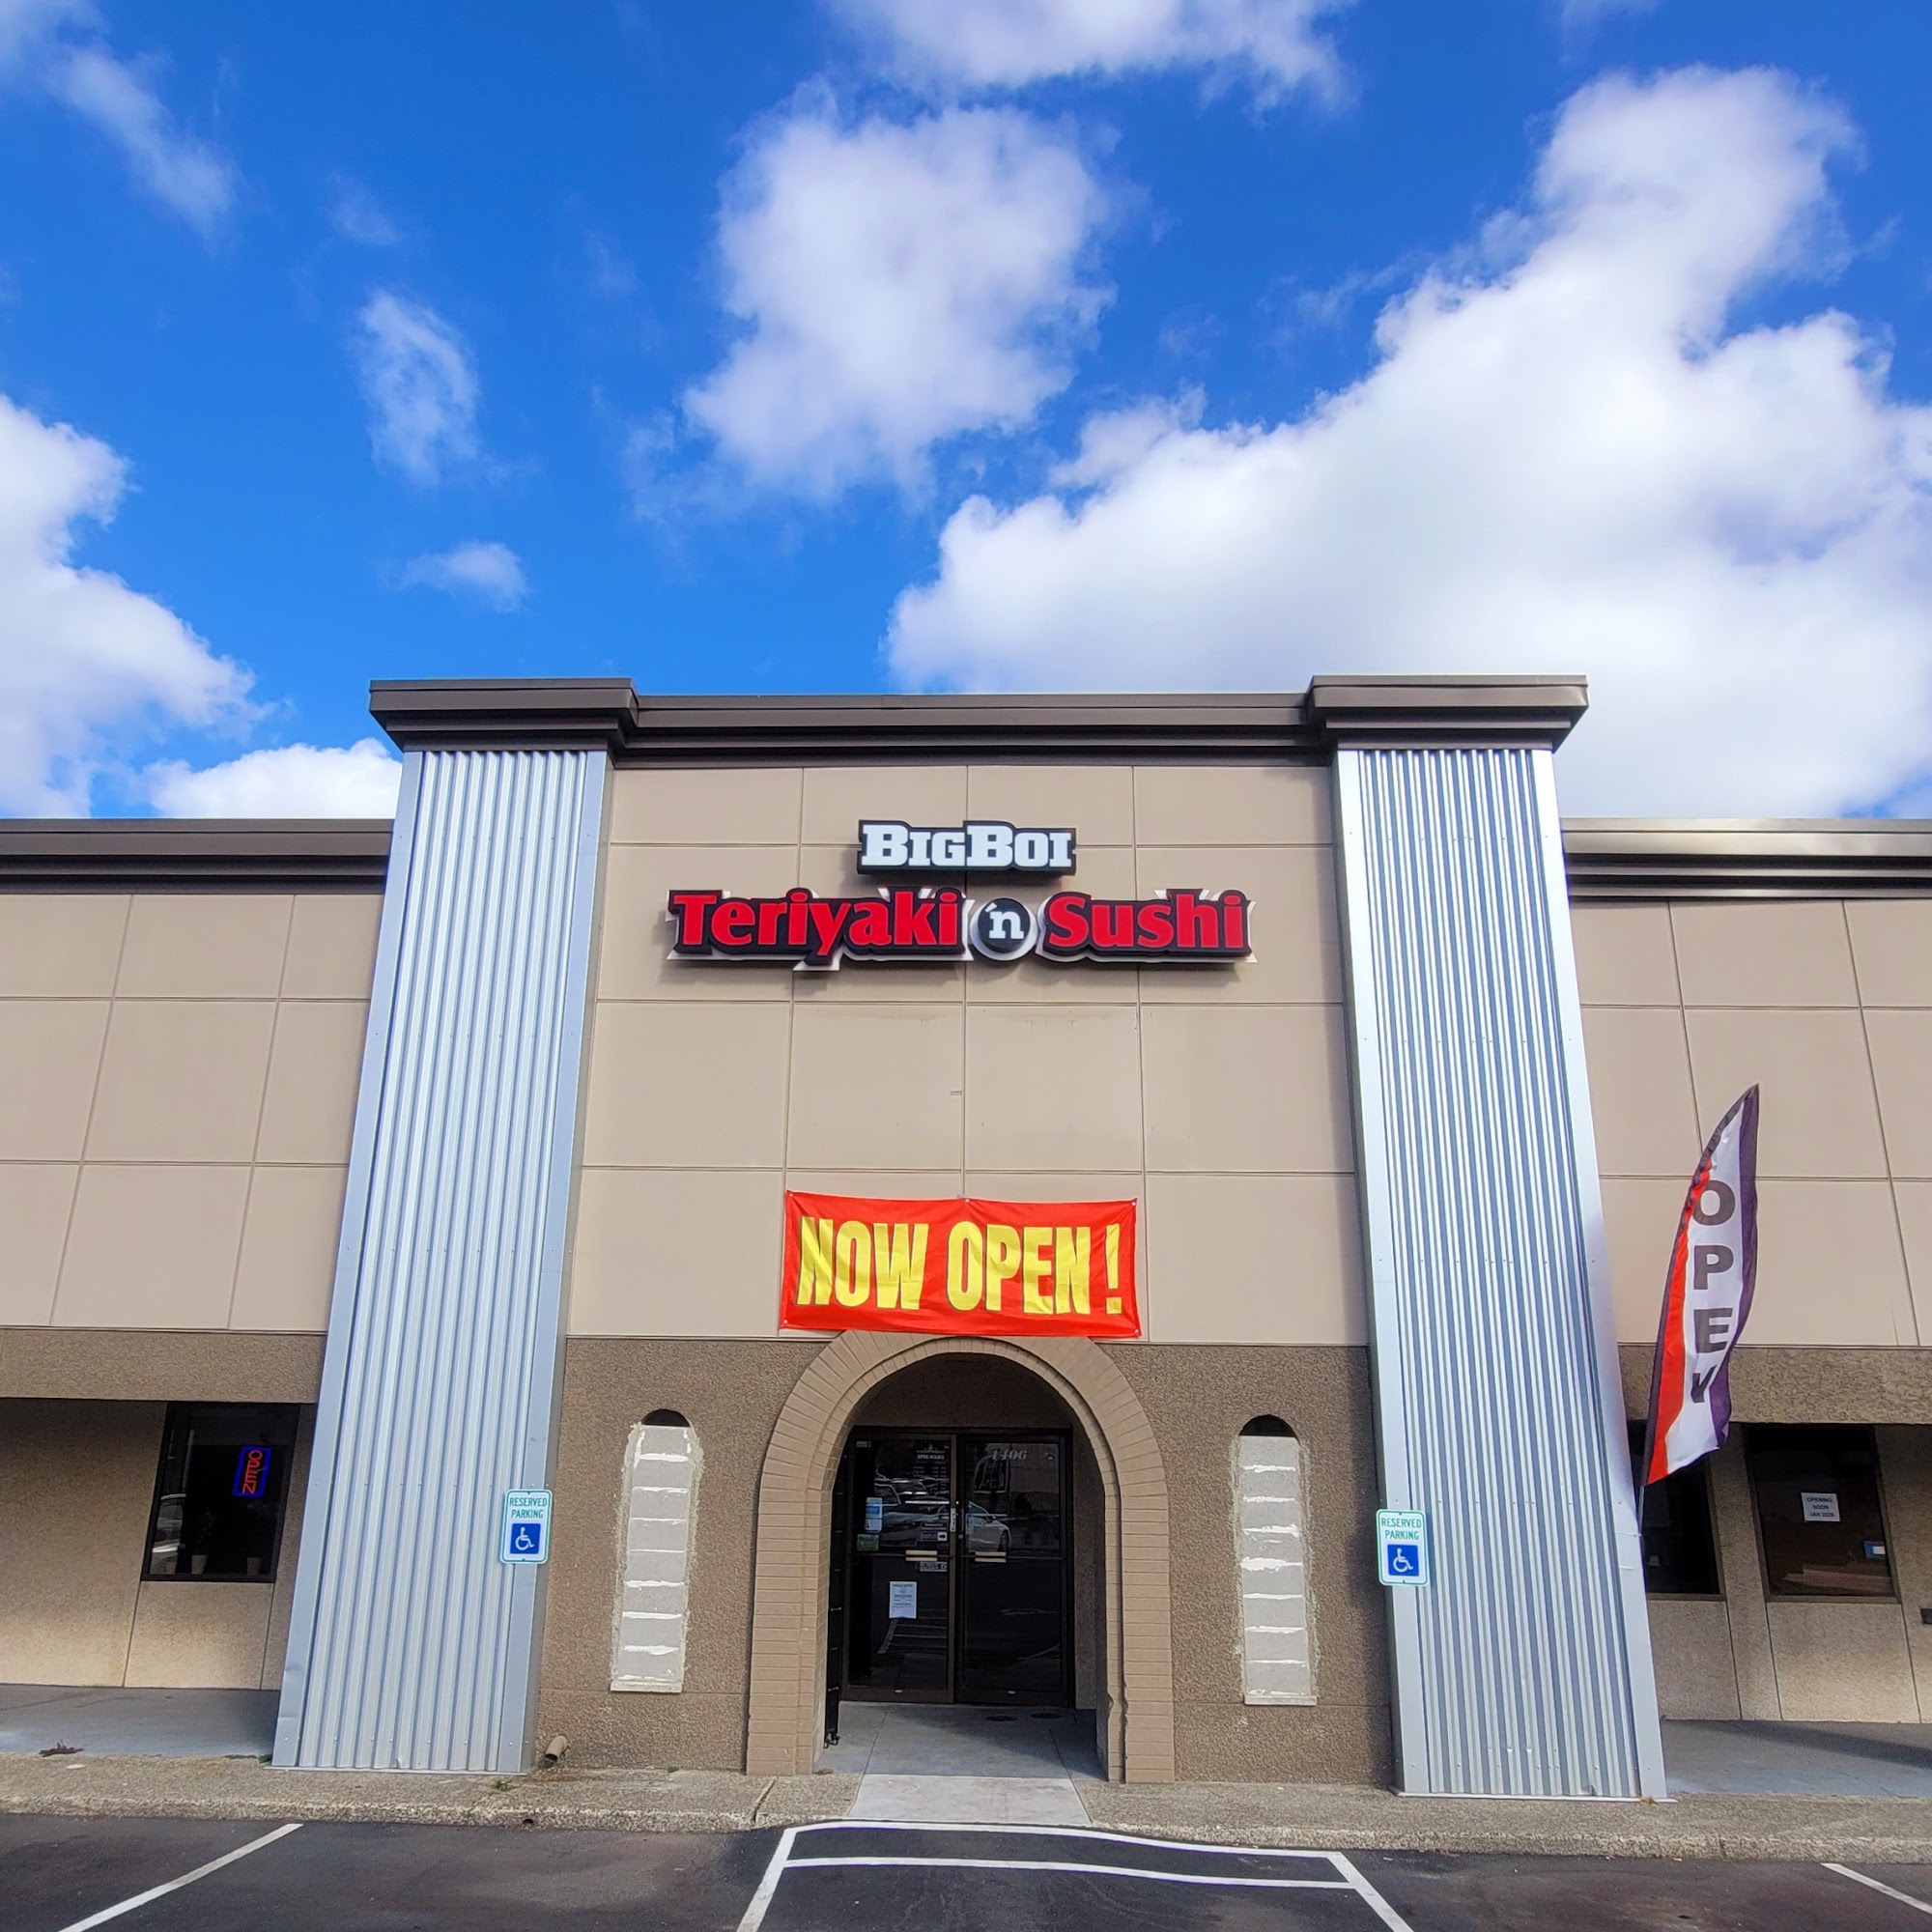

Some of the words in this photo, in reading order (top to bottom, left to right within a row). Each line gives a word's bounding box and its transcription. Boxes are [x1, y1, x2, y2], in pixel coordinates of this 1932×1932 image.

[674, 891, 961, 956] Teriyaki
[1048, 895, 1249, 950] Sushi
[796, 1216, 929, 1310] NOW
[242, 1450, 263, 1494] OPEN
[509, 1497, 547, 1507] RESERVED
[511, 1509, 544, 1519] PARKING
[1380, 1518, 1422, 1528] RESERVED
[1384, 1529, 1420, 1541] PARKING
